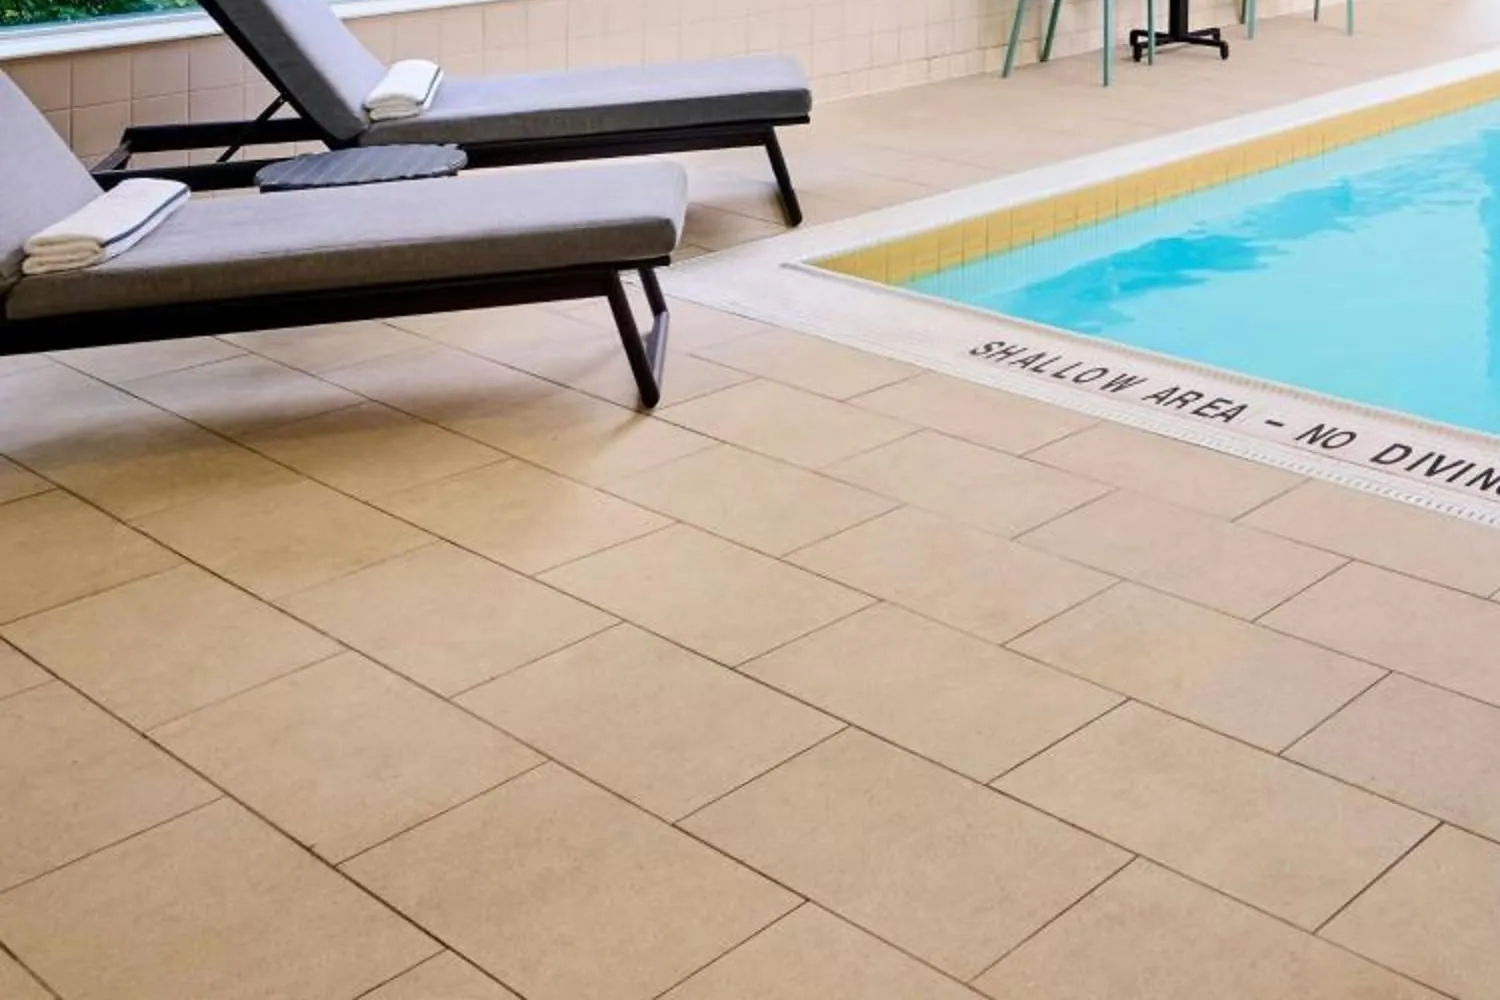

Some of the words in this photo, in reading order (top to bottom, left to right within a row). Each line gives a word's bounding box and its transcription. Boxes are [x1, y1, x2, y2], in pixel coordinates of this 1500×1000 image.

[968, 340, 1149, 395] SHALLOW
[1145, 386, 1249, 423] AREA
[1294, 422, 1358, 450] NO
